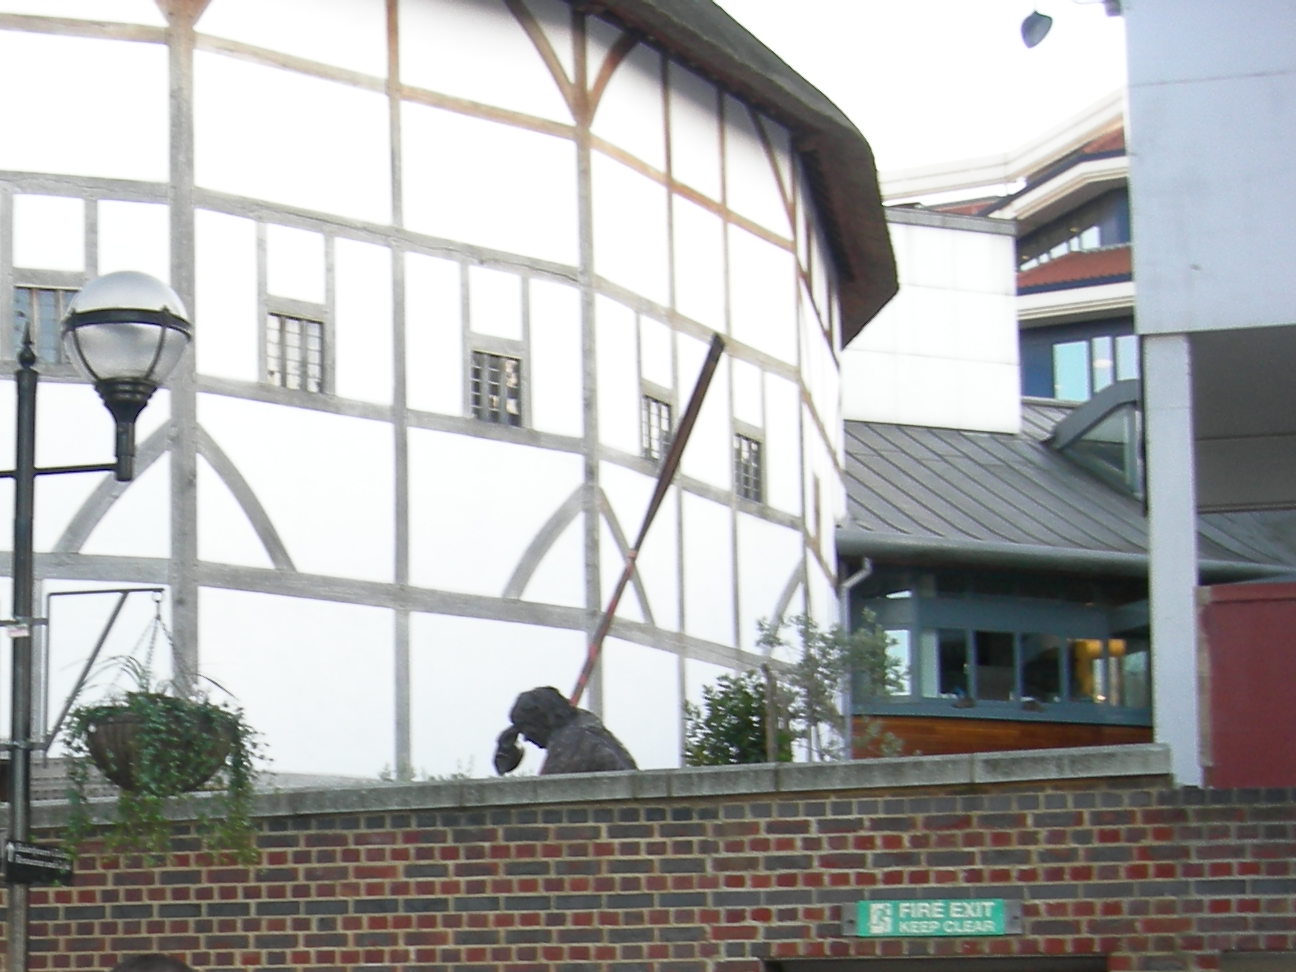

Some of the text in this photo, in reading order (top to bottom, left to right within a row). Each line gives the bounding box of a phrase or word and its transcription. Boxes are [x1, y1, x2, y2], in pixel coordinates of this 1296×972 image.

[899, 901, 995, 918] FIRE EXIT
[899, 920, 995, 933] KEEP CLEAR
